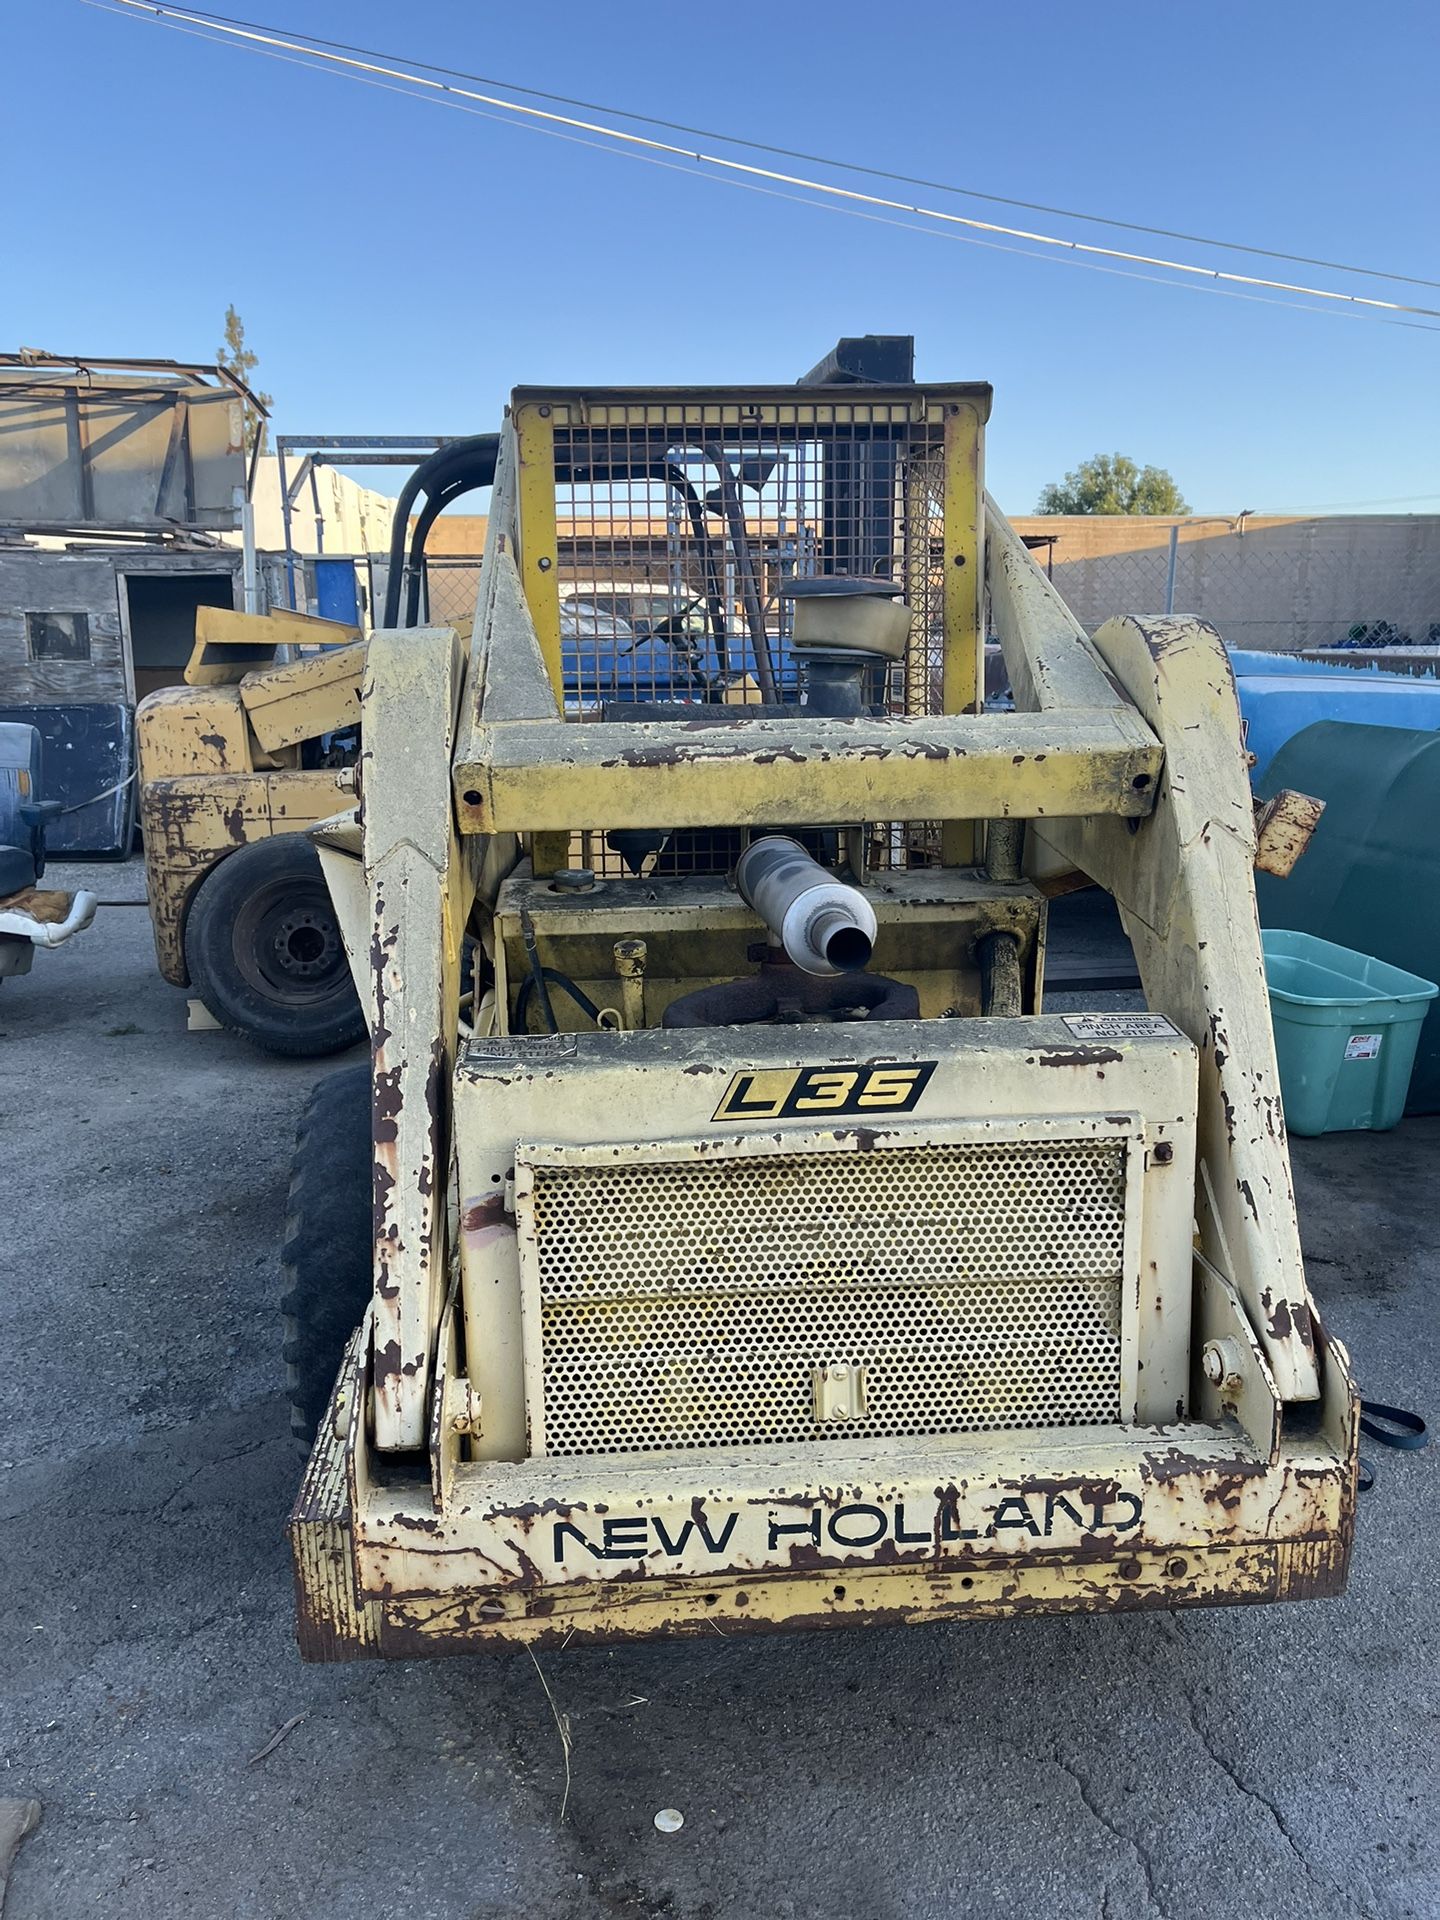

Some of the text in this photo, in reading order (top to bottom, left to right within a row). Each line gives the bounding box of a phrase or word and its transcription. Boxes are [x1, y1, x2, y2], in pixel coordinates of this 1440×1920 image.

[477, 1045, 522, 1053] PINCH
[553, 1492, 1142, 1563] NEW HOLLAND
